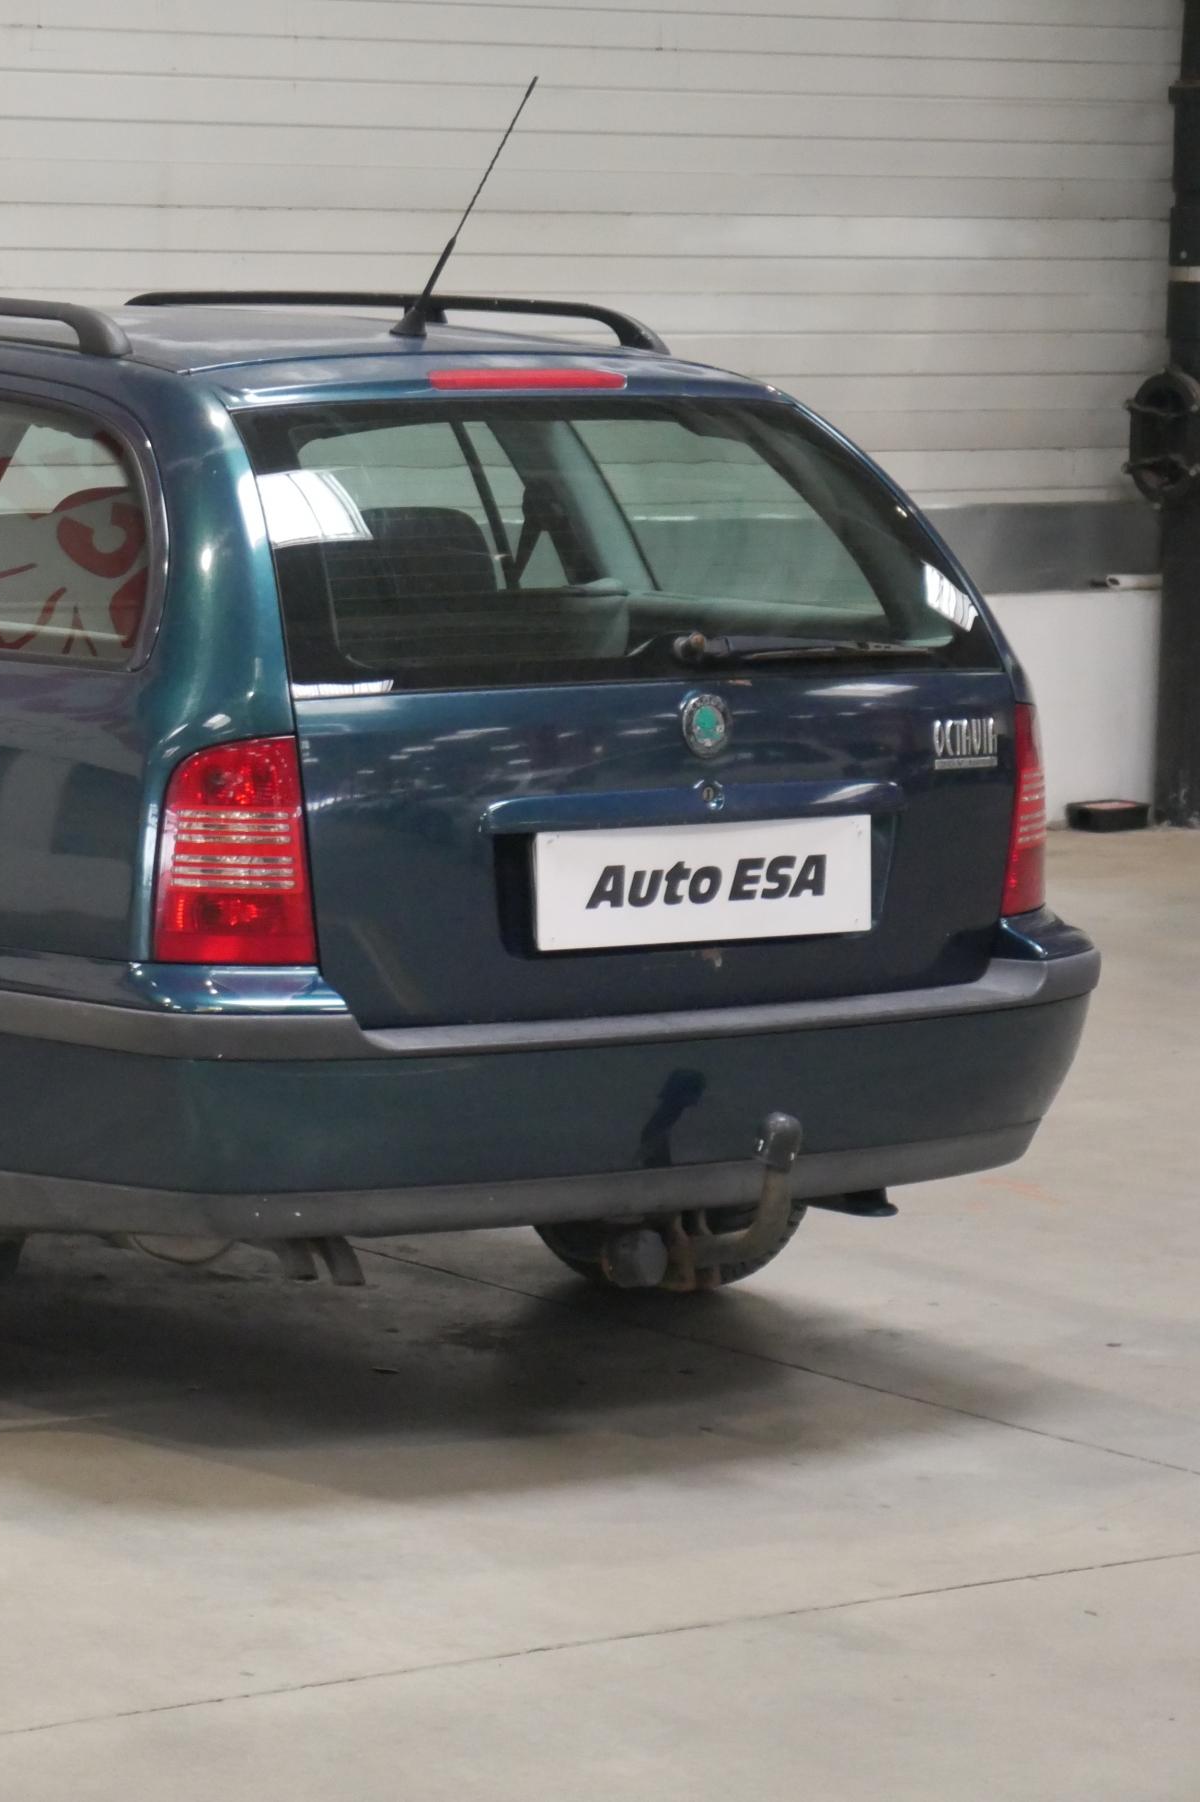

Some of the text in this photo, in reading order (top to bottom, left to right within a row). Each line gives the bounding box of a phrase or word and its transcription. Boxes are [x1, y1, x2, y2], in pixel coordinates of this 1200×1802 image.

[932, 717, 998, 756] OCTAVIA
[585, 854, 827, 909] Auto ESA
